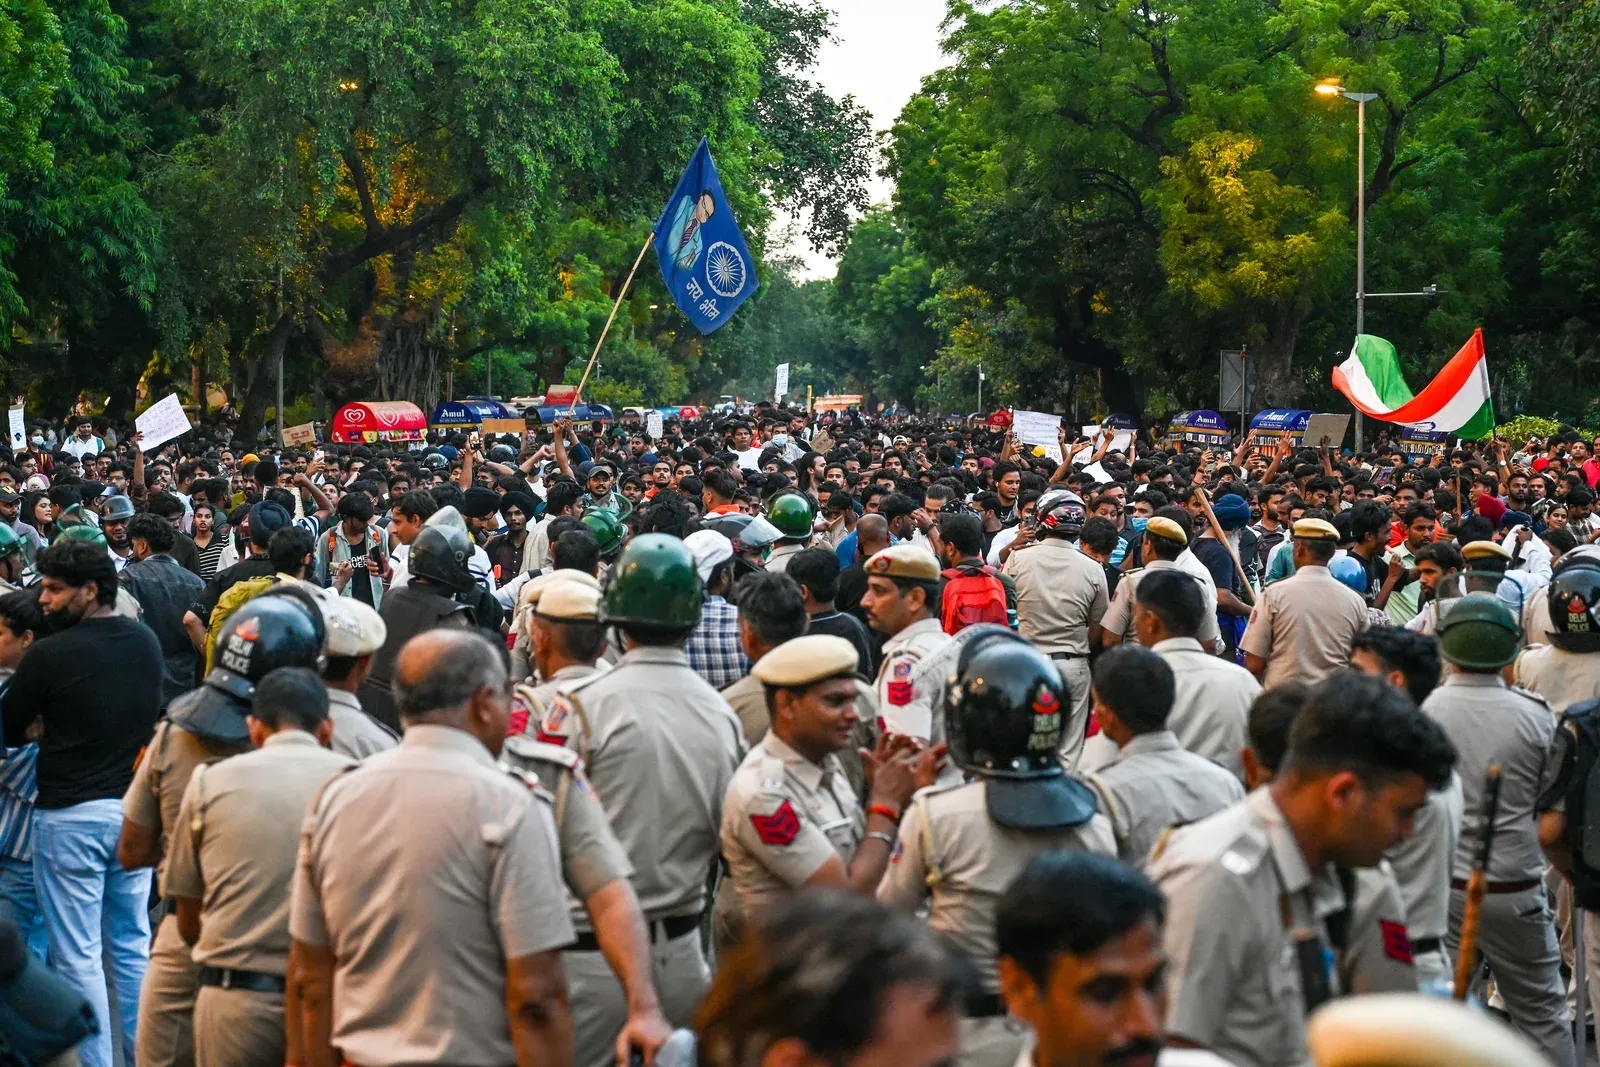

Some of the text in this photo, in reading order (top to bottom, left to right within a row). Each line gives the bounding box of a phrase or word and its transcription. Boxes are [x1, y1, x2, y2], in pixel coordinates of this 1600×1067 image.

[686, 277, 720, 321] जय भीम
[441, 408, 465, 418] Amul
[1195, 414, 1217, 424] Amul
[351, 554, 368, 562] AME
[352, 561, 368, 569] VER
[228, 634, 254, 657] DELHI
[221, 650, 252, 675] POLICE
